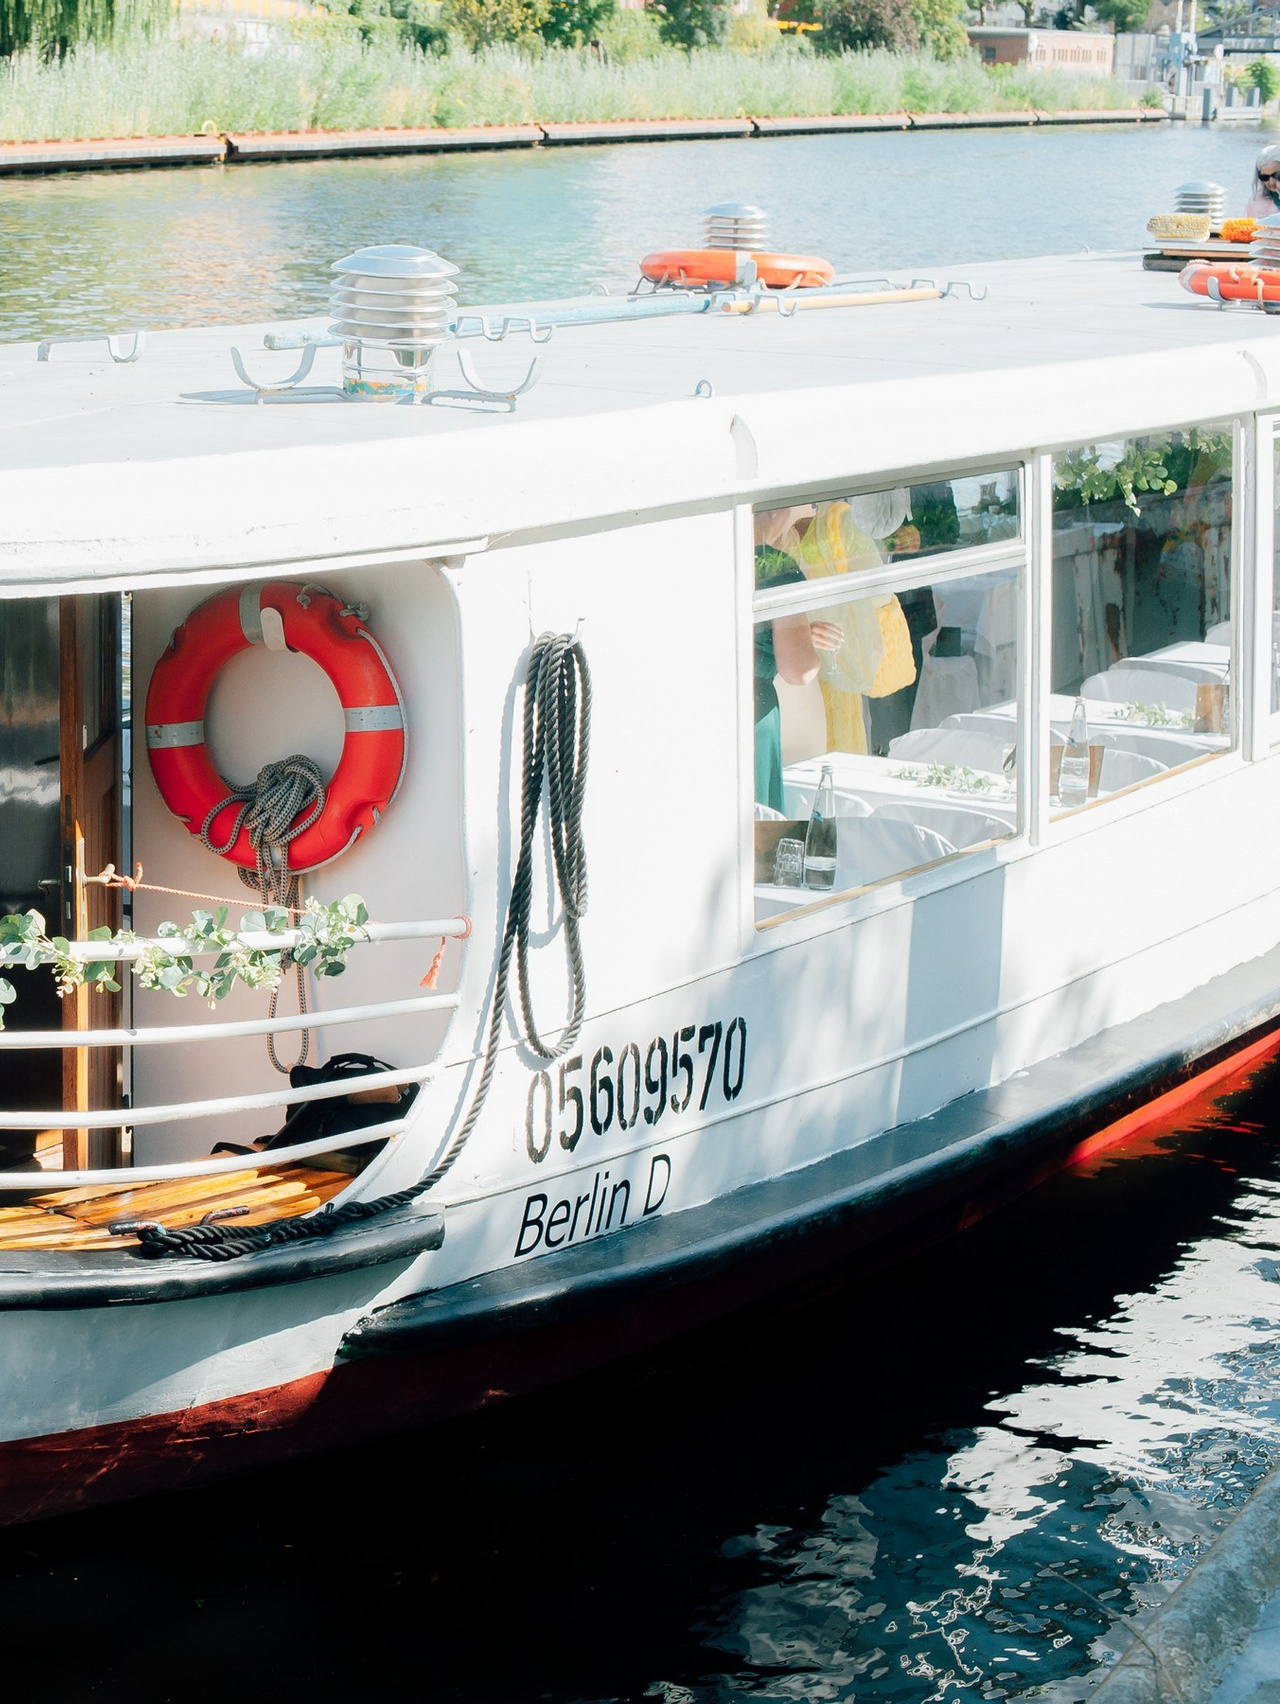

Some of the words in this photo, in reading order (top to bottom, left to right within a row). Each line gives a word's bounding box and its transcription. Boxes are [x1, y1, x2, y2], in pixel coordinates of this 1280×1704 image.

[525, 1016, 747, 1164] 05609570
[513, 1171, 631, 1258] Berlin
[642, 1153, 671, 1217] D
